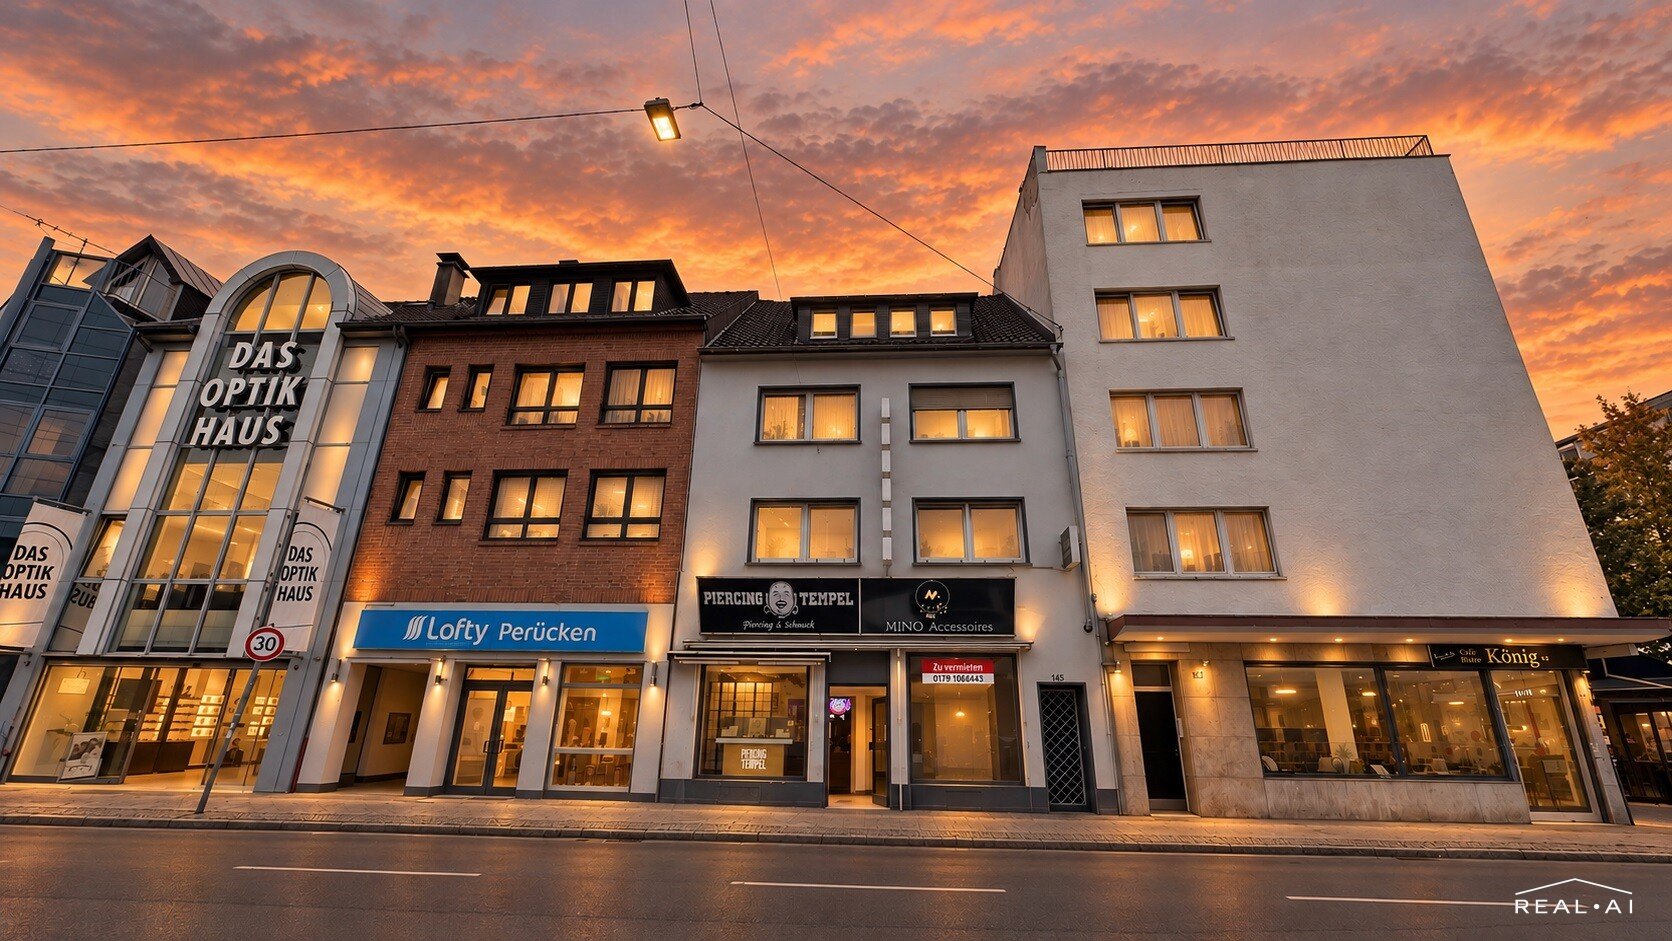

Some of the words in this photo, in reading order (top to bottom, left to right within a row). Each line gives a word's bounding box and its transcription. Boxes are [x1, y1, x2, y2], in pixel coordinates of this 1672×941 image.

[228, 341, 298, 369] DAS
[200, 376, 303, 407] OPTIK
[189, 415, 284, 445] HAUS
[13, 545, 49, 562] DAS
[288, 546, 313, 562] DAS
[2, 564, 55, 580] OPTIK
[280, 566, 319, 581] OPTIK
[0, 583, 48, 599] HAUS
[276, 586, 313, 601] HAUS
[703, 591, 763, 605] PIERCING
[799, 591, 855, 606] TEMPEL
[427, 616, 489, 646] Lofty
[498, 621, 597, 642] Perücken
[742, 620, 774, 631] Piercing
[886, 621, 924, 632] MINO
[929, 621, 994, 632] Accessoires
[253, 636, 277, 652] 30
[1485, 648, 1540, 668] König
[933, 662, 943, 671] Zu
[944, 662, 983, 672] vermieten
